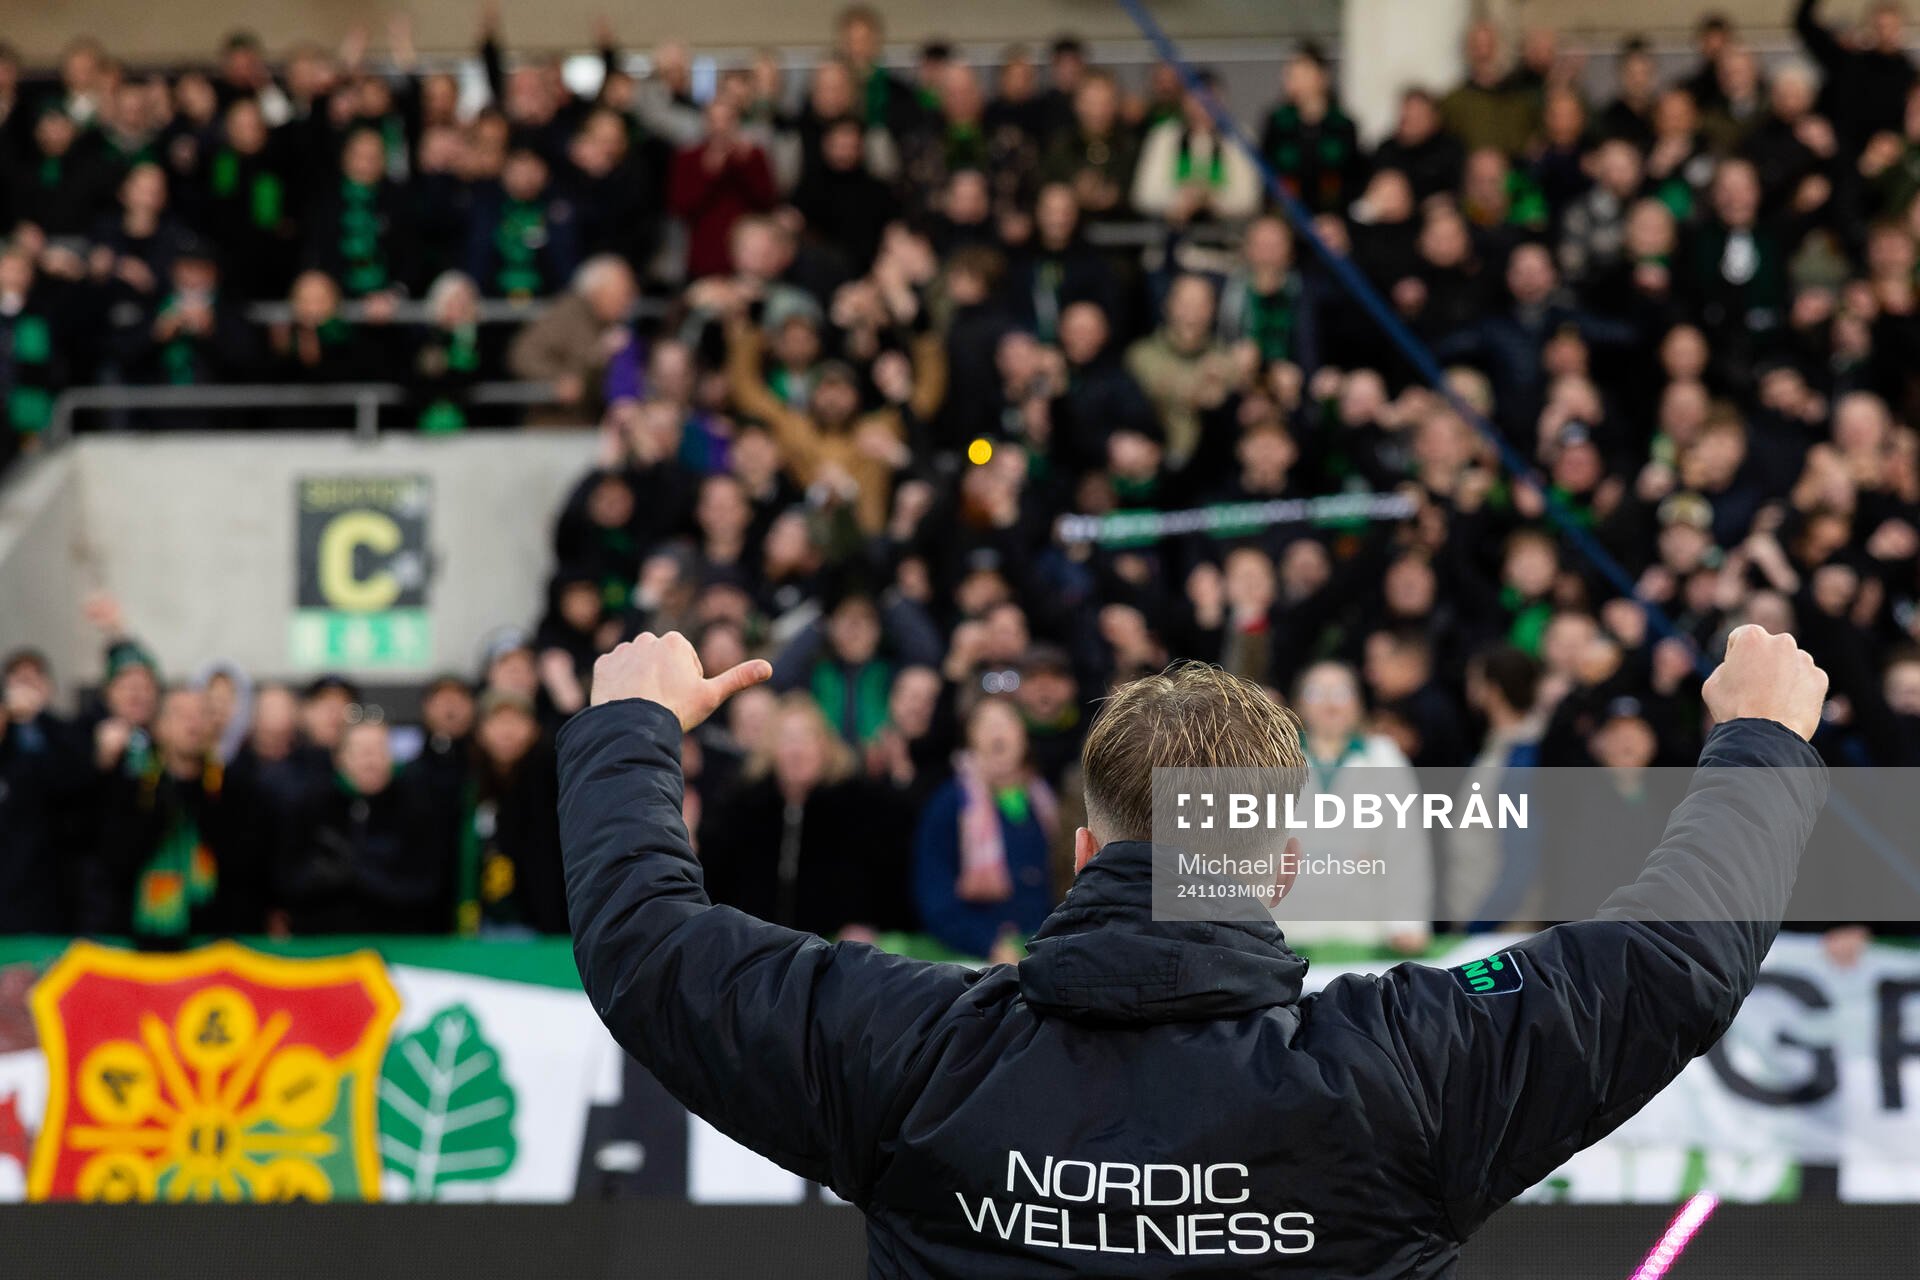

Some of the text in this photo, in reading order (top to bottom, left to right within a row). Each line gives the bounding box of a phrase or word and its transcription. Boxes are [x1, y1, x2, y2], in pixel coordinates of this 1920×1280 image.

[317, 508, 403, 613] C
[1006, 1150, 1250, 1206] NORDIC
[955, 1192, 1315, 1256] WELLNESS
